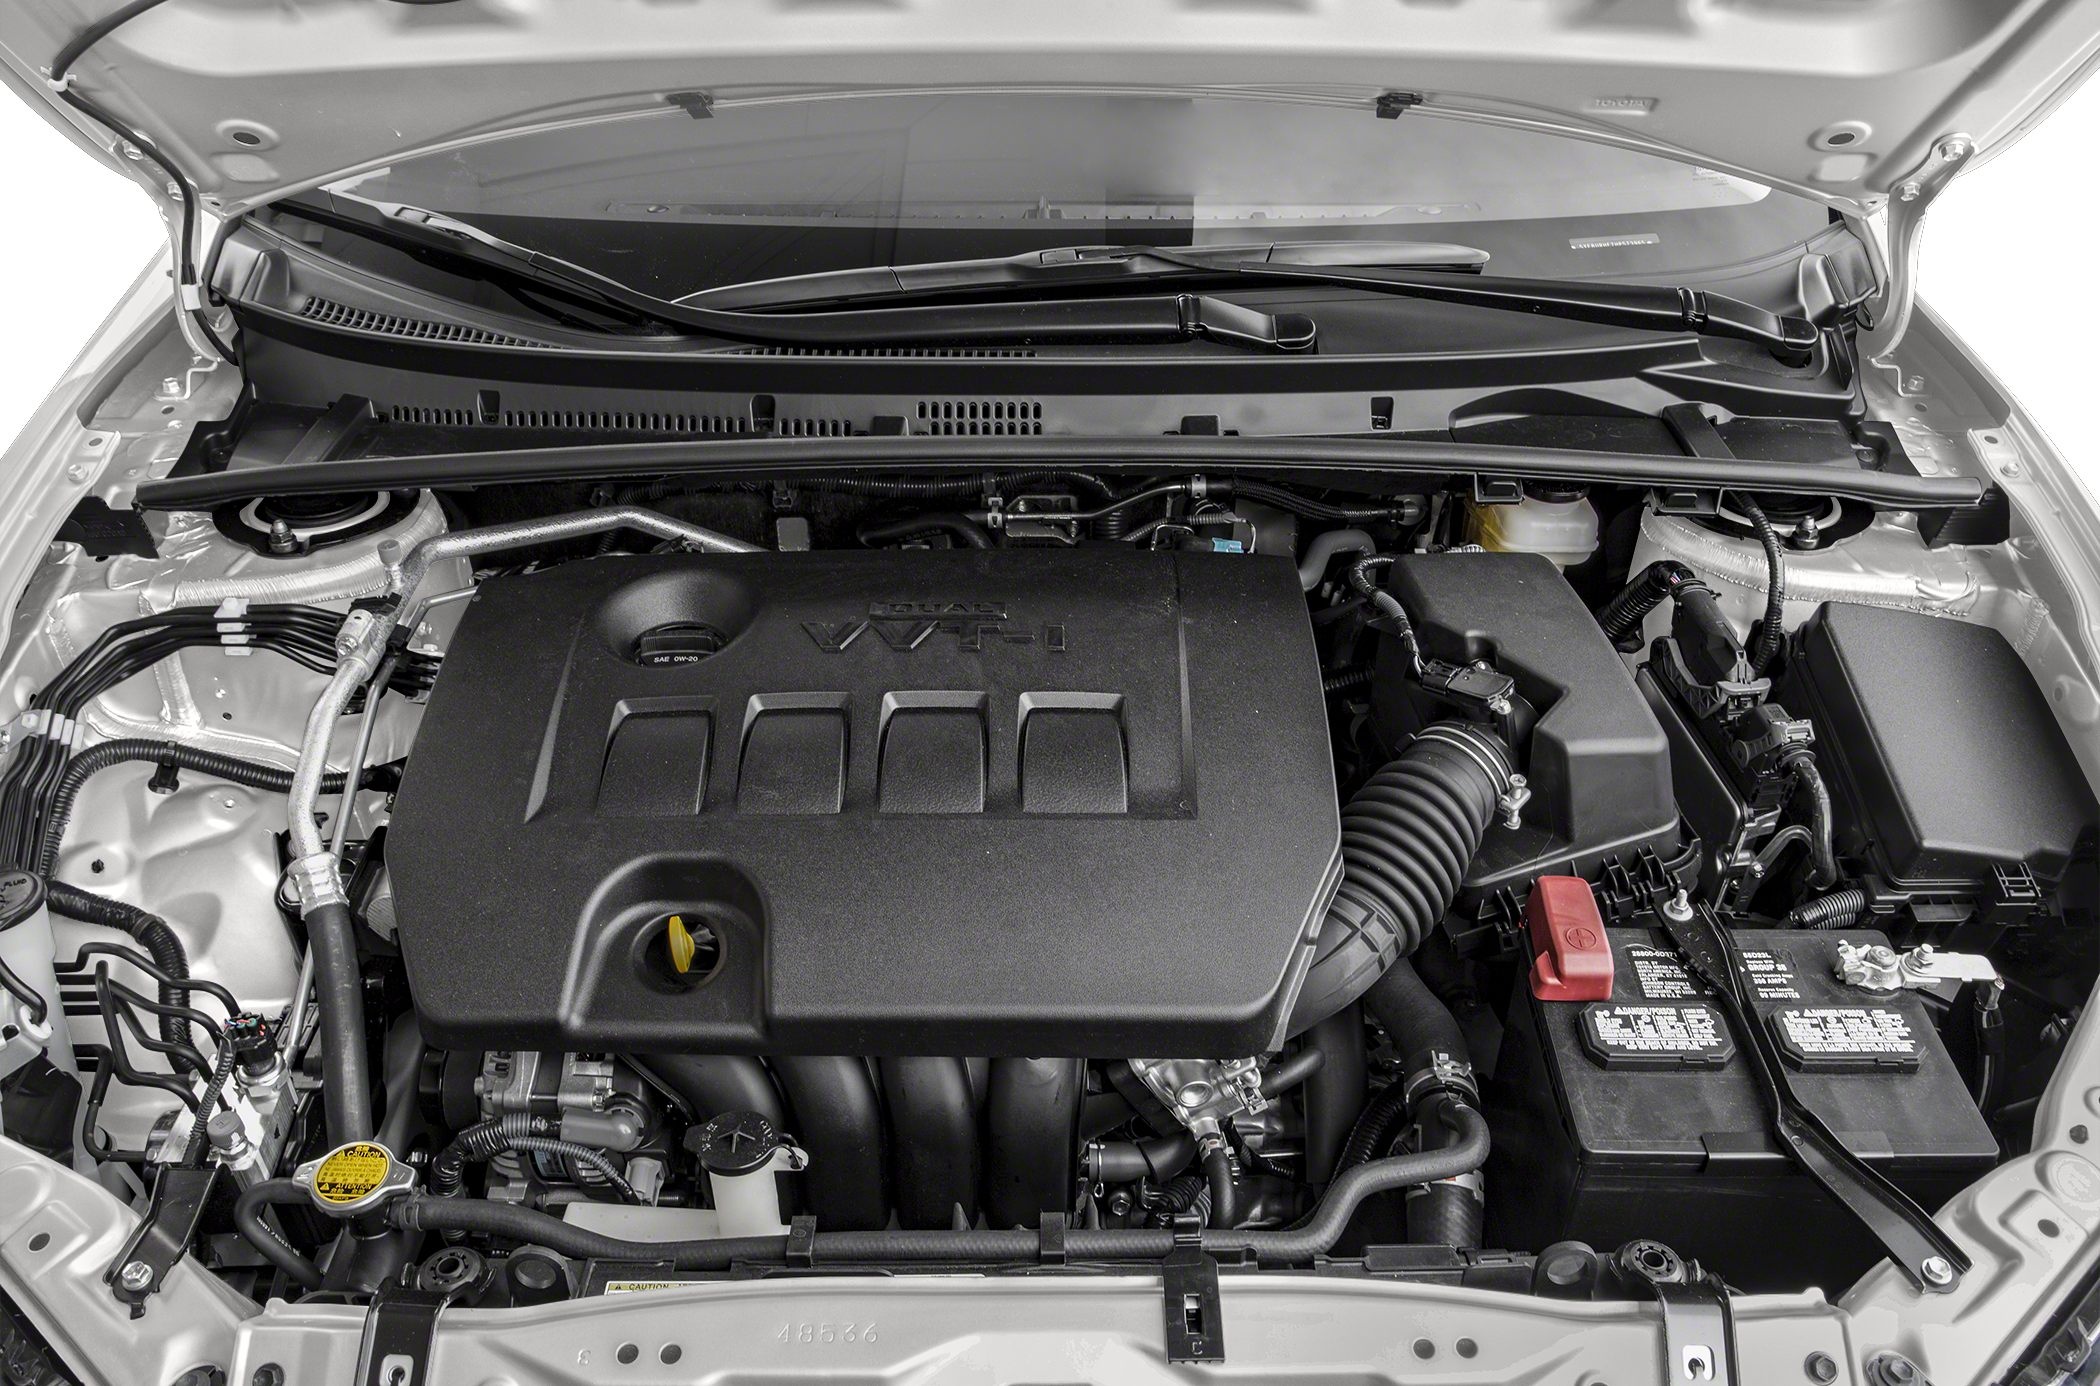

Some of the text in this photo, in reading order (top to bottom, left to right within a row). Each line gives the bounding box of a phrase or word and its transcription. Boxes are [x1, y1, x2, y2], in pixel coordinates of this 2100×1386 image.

[1595, 98, 1647, 107] TOYOTA
[888, 602, 994, 614] DUAL
[1747, 963, 1775, 972] GROUP
[628, 1283, 669, 1291] CAUTION
